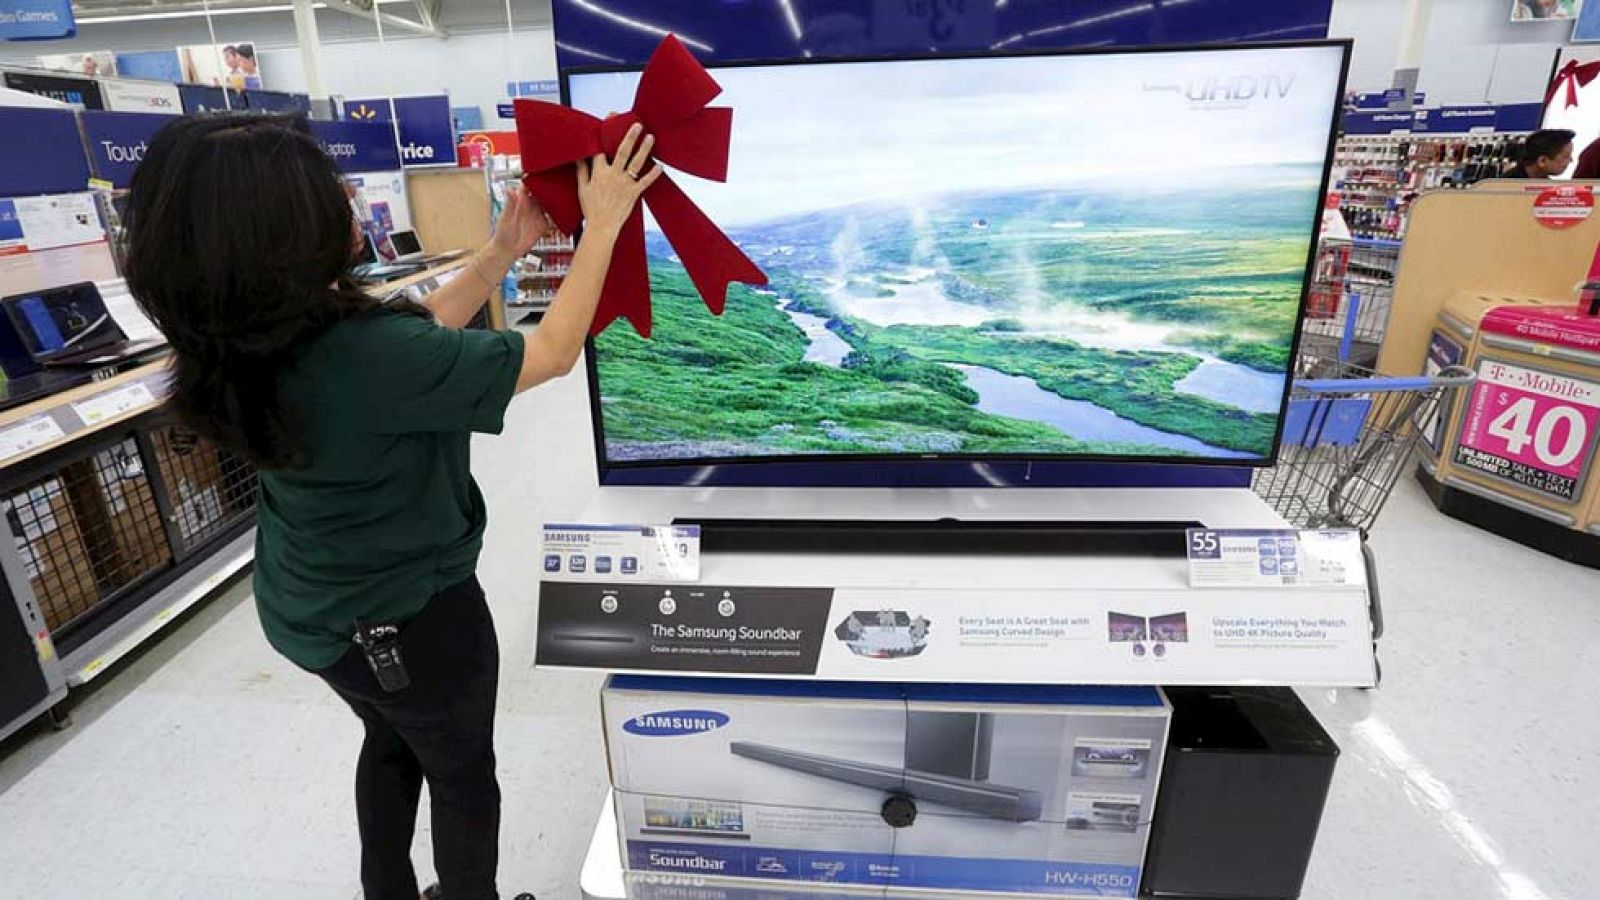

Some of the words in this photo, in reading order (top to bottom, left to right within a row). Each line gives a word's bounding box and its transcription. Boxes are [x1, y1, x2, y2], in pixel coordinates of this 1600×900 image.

[16, 10, 58, 23] Games
[400, 142, 434, 159] rice
[1489, 397, 1587, 467] 40
[1459, 446, 1509, 468] UNLIMITED
[544, 533, 591, 543] SAMSUNG
[1193, 532, 1217, 552] 55
[985, 616, 1005, 625] Seat
[1212, 617, 1248, 628] Upscale
[1249, 618, 1298, 629] Everything
[651, 624, 675, 638] The
[677, 624, 737, 641] Samsung
[739, 627, 802, 641] Soundbar
[959, 626, 1000, 637] Samsung
[1001, 626, 1033, 636] Curved
[1036, 627, 1065, 638] Design
[1260, 628, 1293, 638] Picture
[1294, 629, 1327, 640] Quality
[635, 715, 717, 731] SAMSUNG
[650, 853, 727, 870] Soundbar
[1044, 870, 1133, 887] HW-H550
